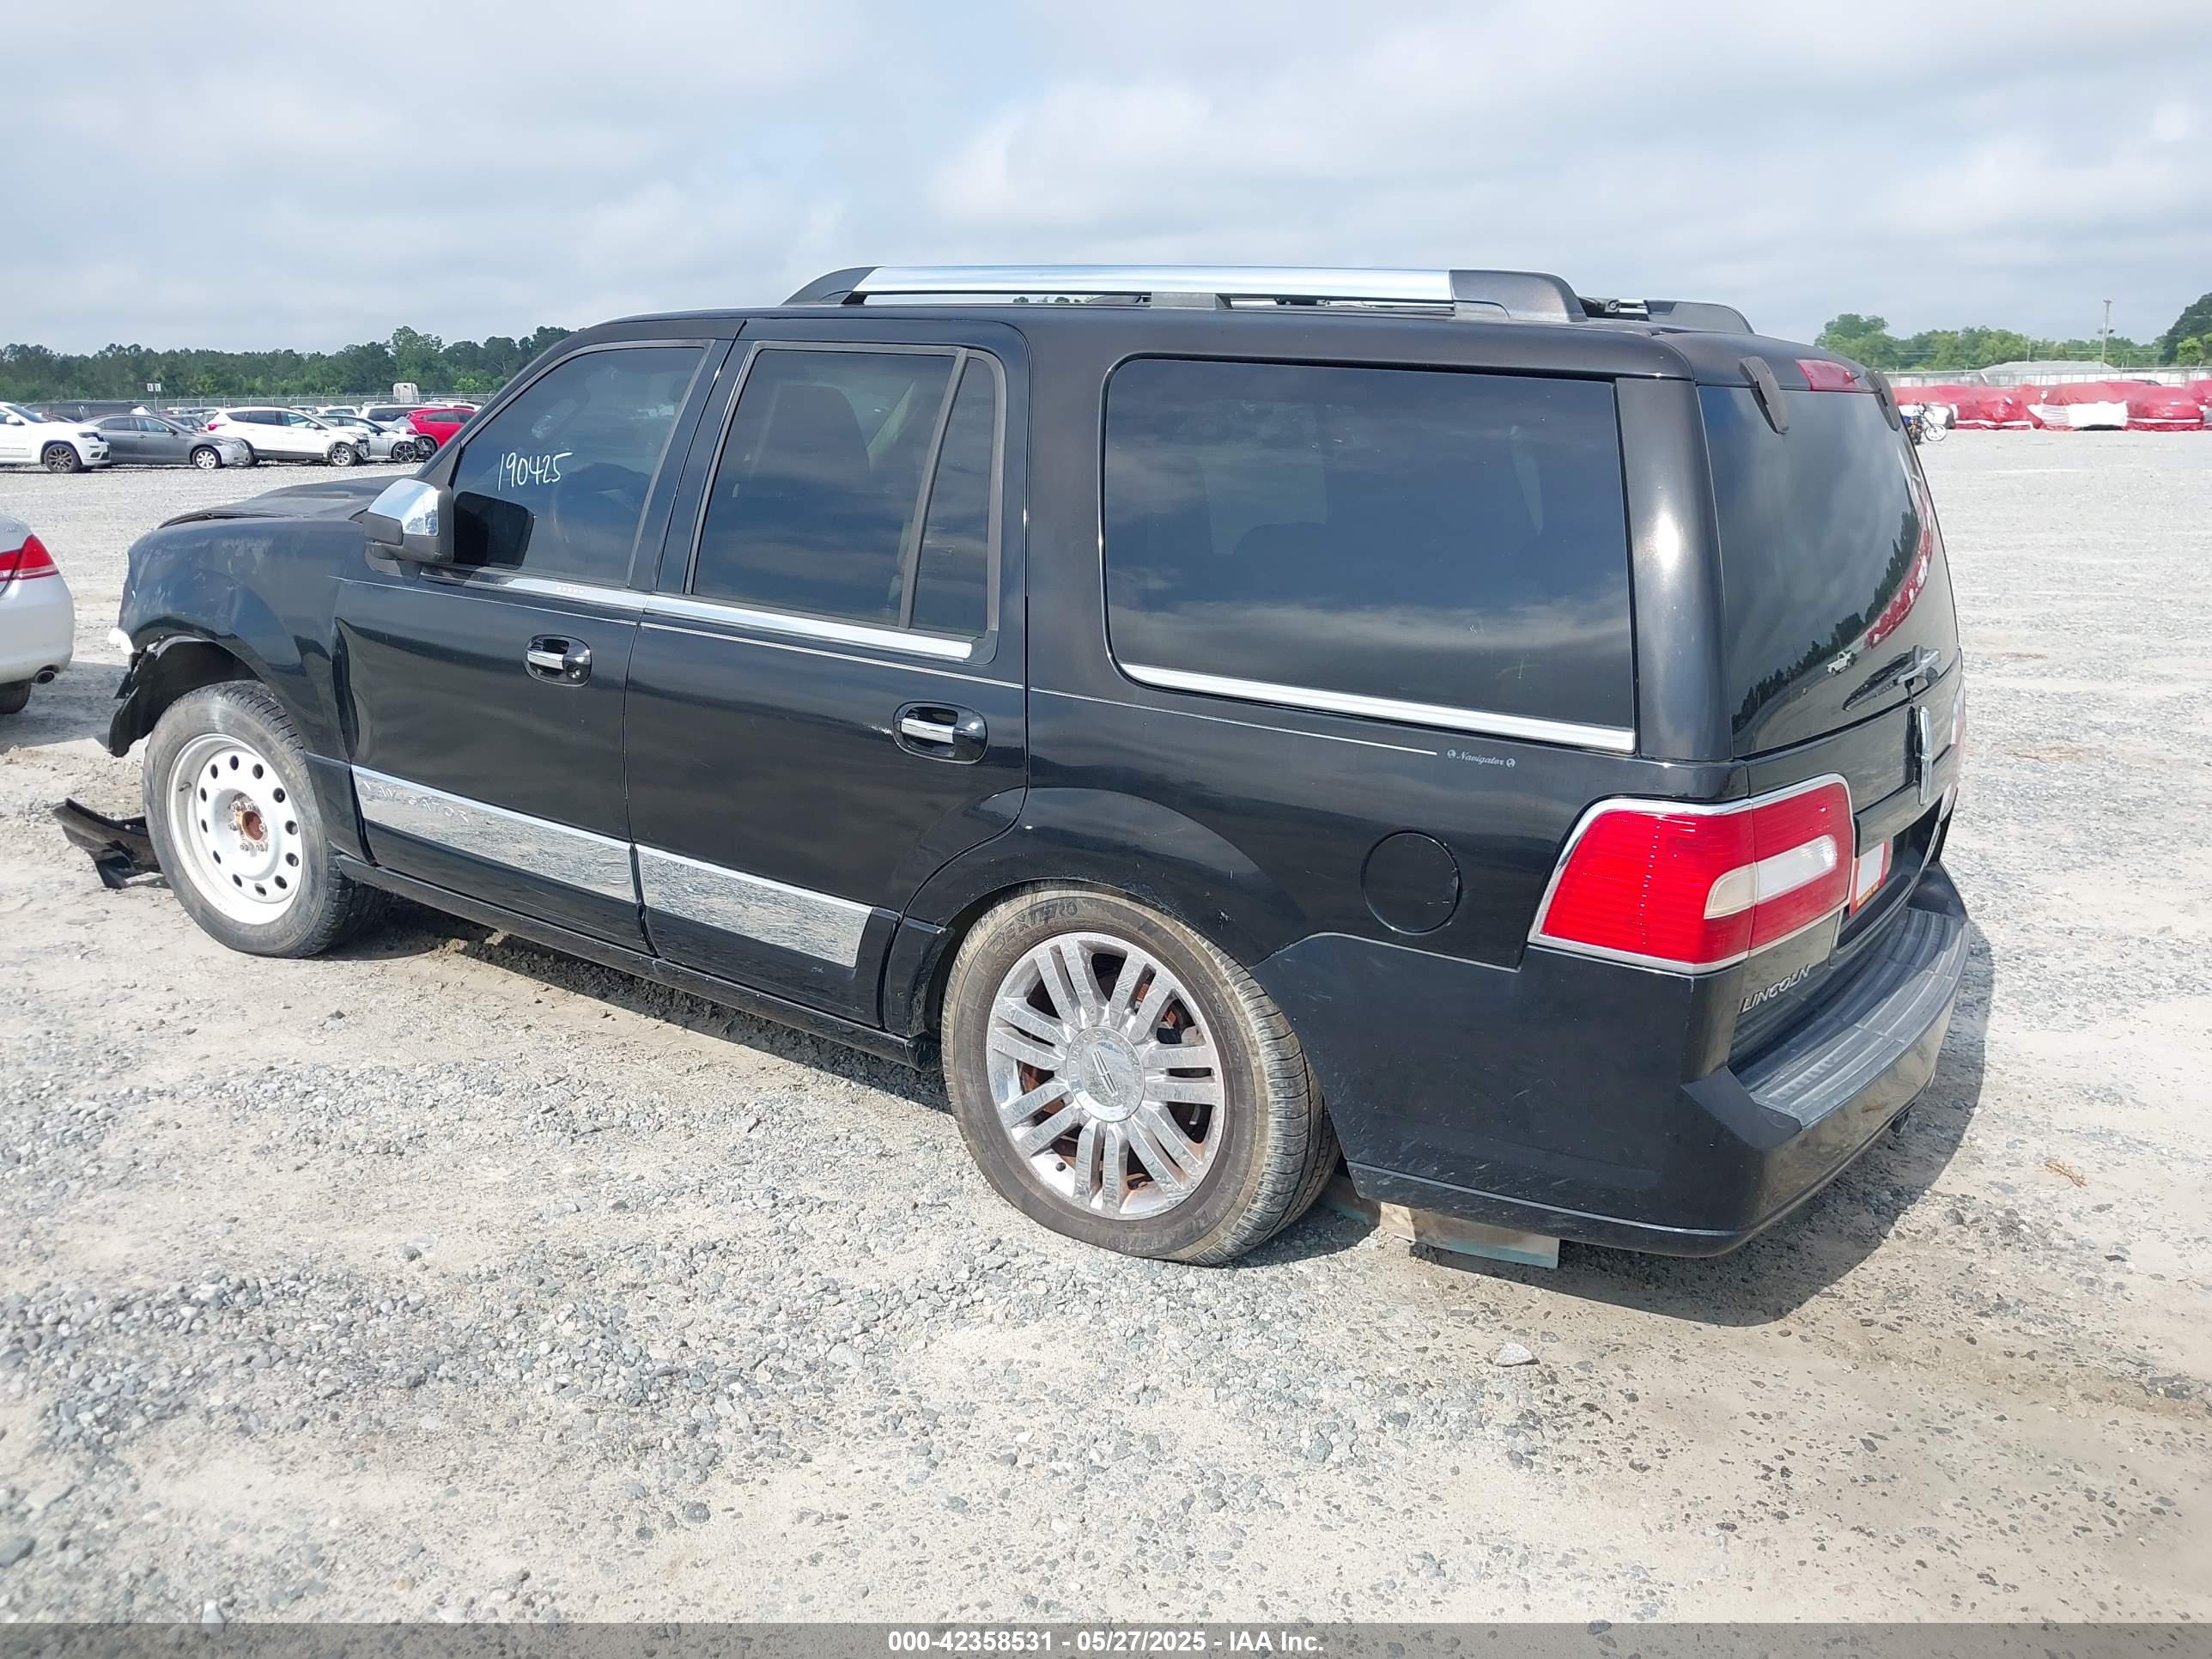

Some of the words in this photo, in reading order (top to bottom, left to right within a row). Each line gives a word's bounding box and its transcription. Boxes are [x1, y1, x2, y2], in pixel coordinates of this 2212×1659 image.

[498, 452, 573, 492] 190425
[1456, 750, 1504, 766] Navigator
[1739, 963, 1810, 1014] LINCOLN
